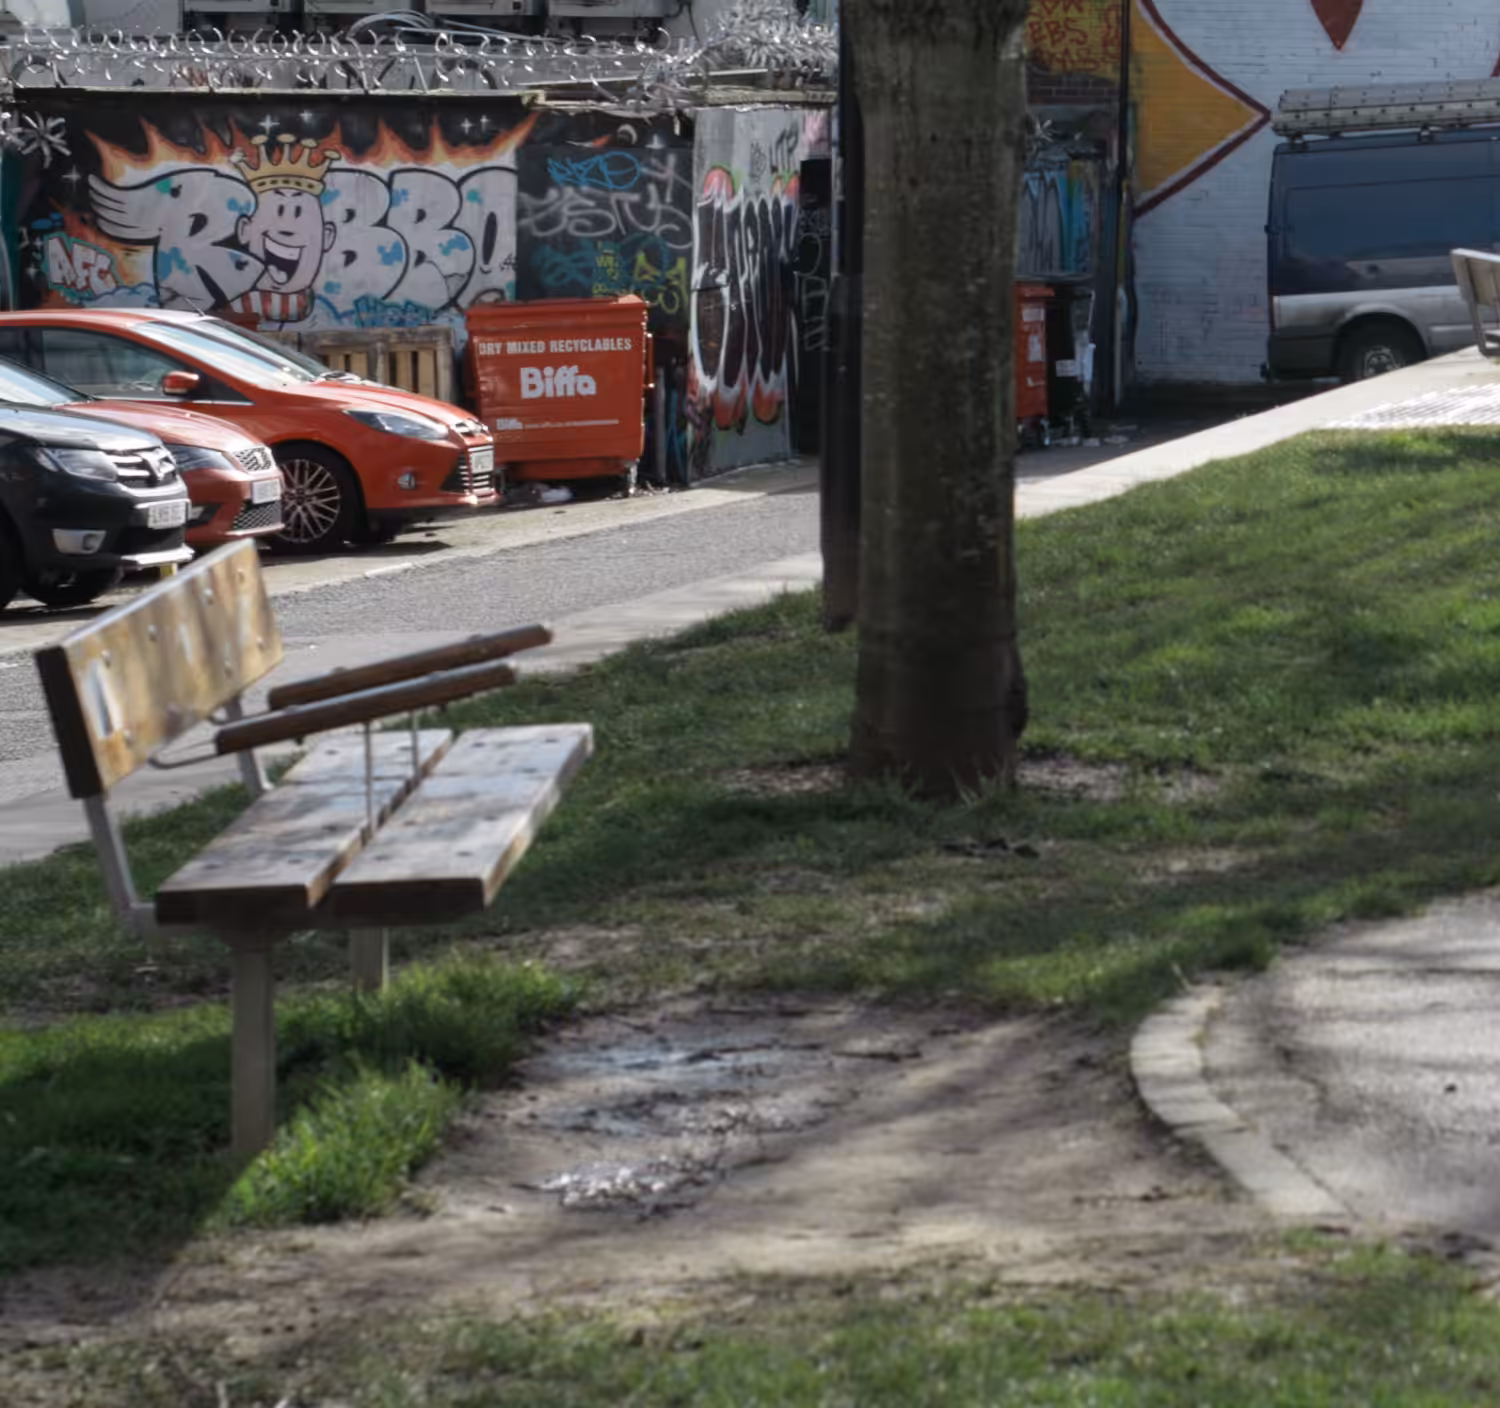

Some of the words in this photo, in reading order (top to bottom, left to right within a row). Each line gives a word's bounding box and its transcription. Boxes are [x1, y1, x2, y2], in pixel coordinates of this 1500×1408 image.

[47, 236, 117, 297] AFC
[478, 342, 503, 356] DRY
[506, 340, 546, 355] MIXED
[550, 338, 633, 353] RECYCLABLES
[520, 365, 597, 399] Biffa
